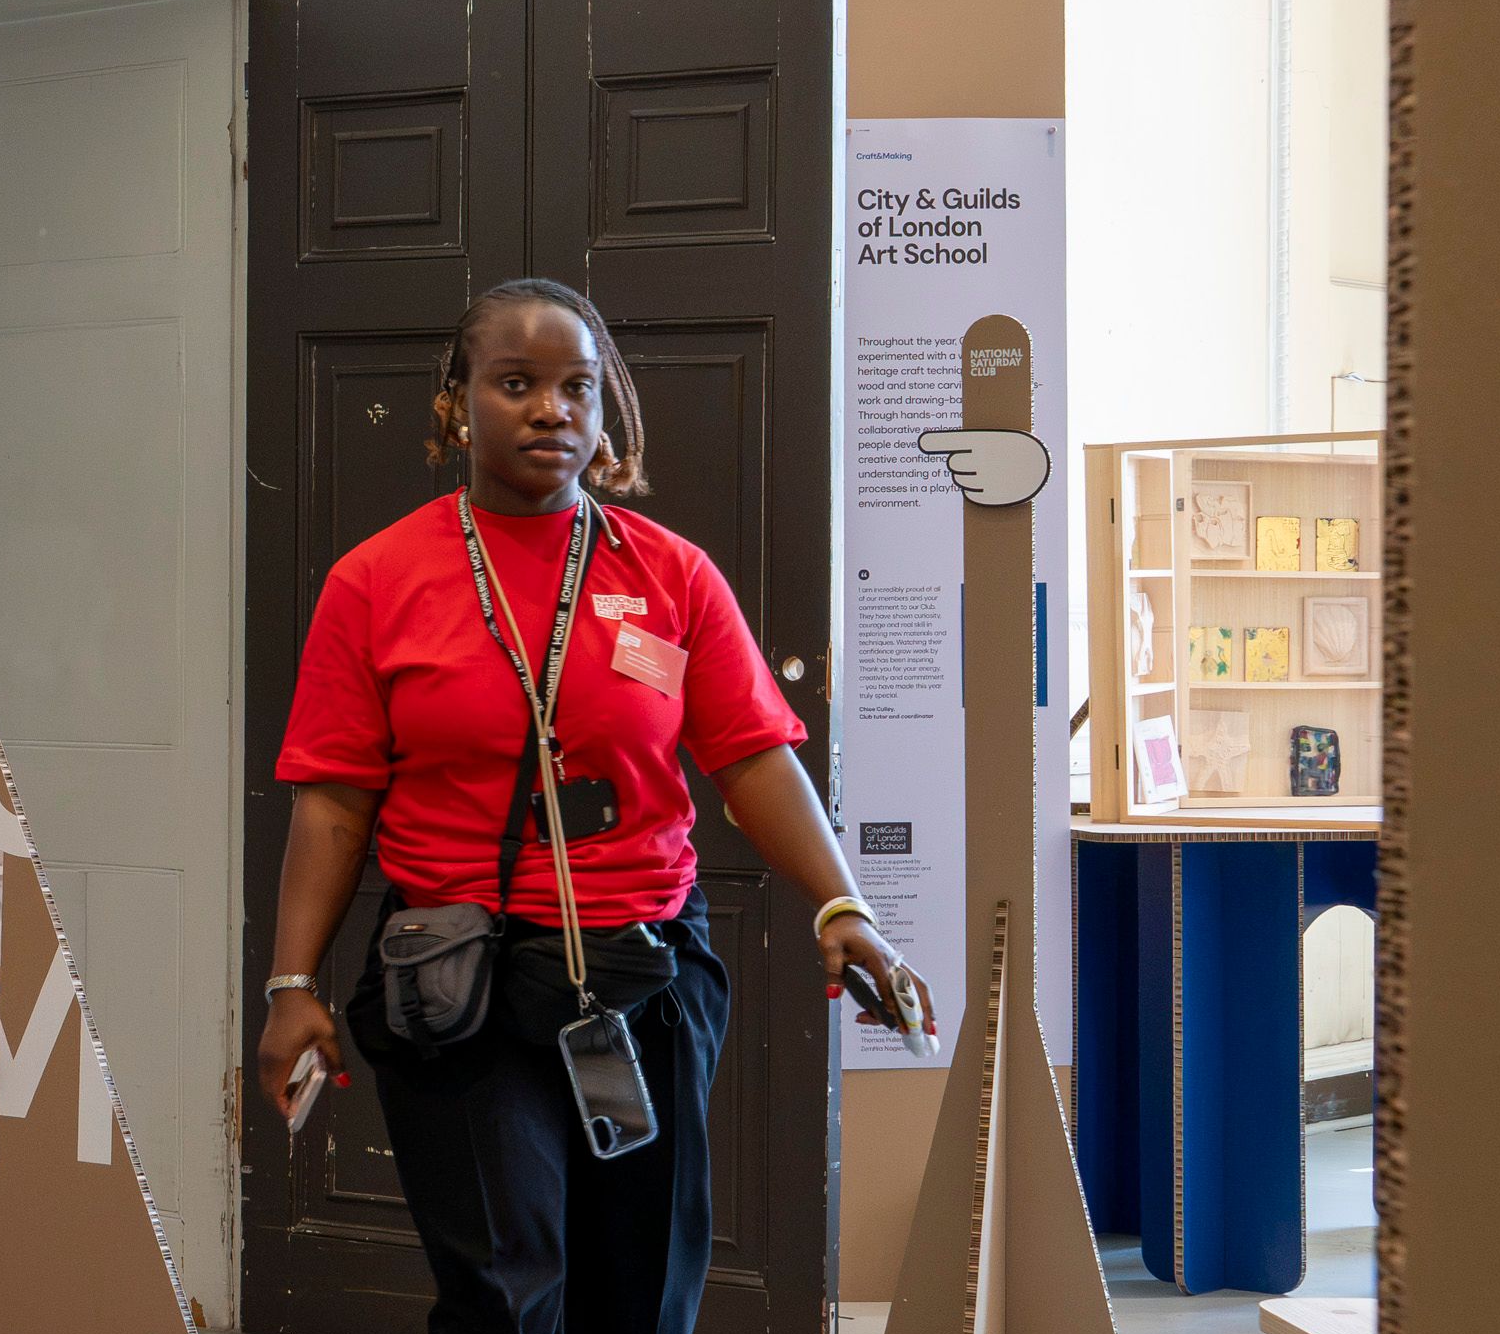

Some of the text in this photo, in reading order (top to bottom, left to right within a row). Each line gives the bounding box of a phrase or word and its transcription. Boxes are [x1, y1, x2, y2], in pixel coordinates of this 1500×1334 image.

[856, 153, 912, 161] Craft&Making
[858, 188, 1020, 216] City & Guilds
[858, 216, 981, 237] of London
[858, 243, 987, 264] Art School
[858, 337, 957, 348] Throughout the year,
[858, 352, 924, 362] experimented
[927, 352, 947, 360] with
[971, 349, 1023, 359] NATIONAL
[971, 358, 1022, 368] SATURDAY
[858, 367, 924, 377] heritage craft
[971, 368, 996, 377] CLUB
[858, 382, 884, 390] wood
[887, 382, 906, 390] and
[858, 411, 947, 421] Through hands-on
[858, 426, 920, 434] collaborative
[858, 441, 891, 451] people
[858, 455, 897, 464] creative
[858, 470, 941, 480] understanding of
[858, 485, 907, 494] processes
[910, 484, 918, 492] in
[858, 499, 921, 508] environment.
[559, 556, 580, 604] SOMERSET
[552, 611, 569, 646] HOUSE
[865, 826, 907, 835] City&Guilds
